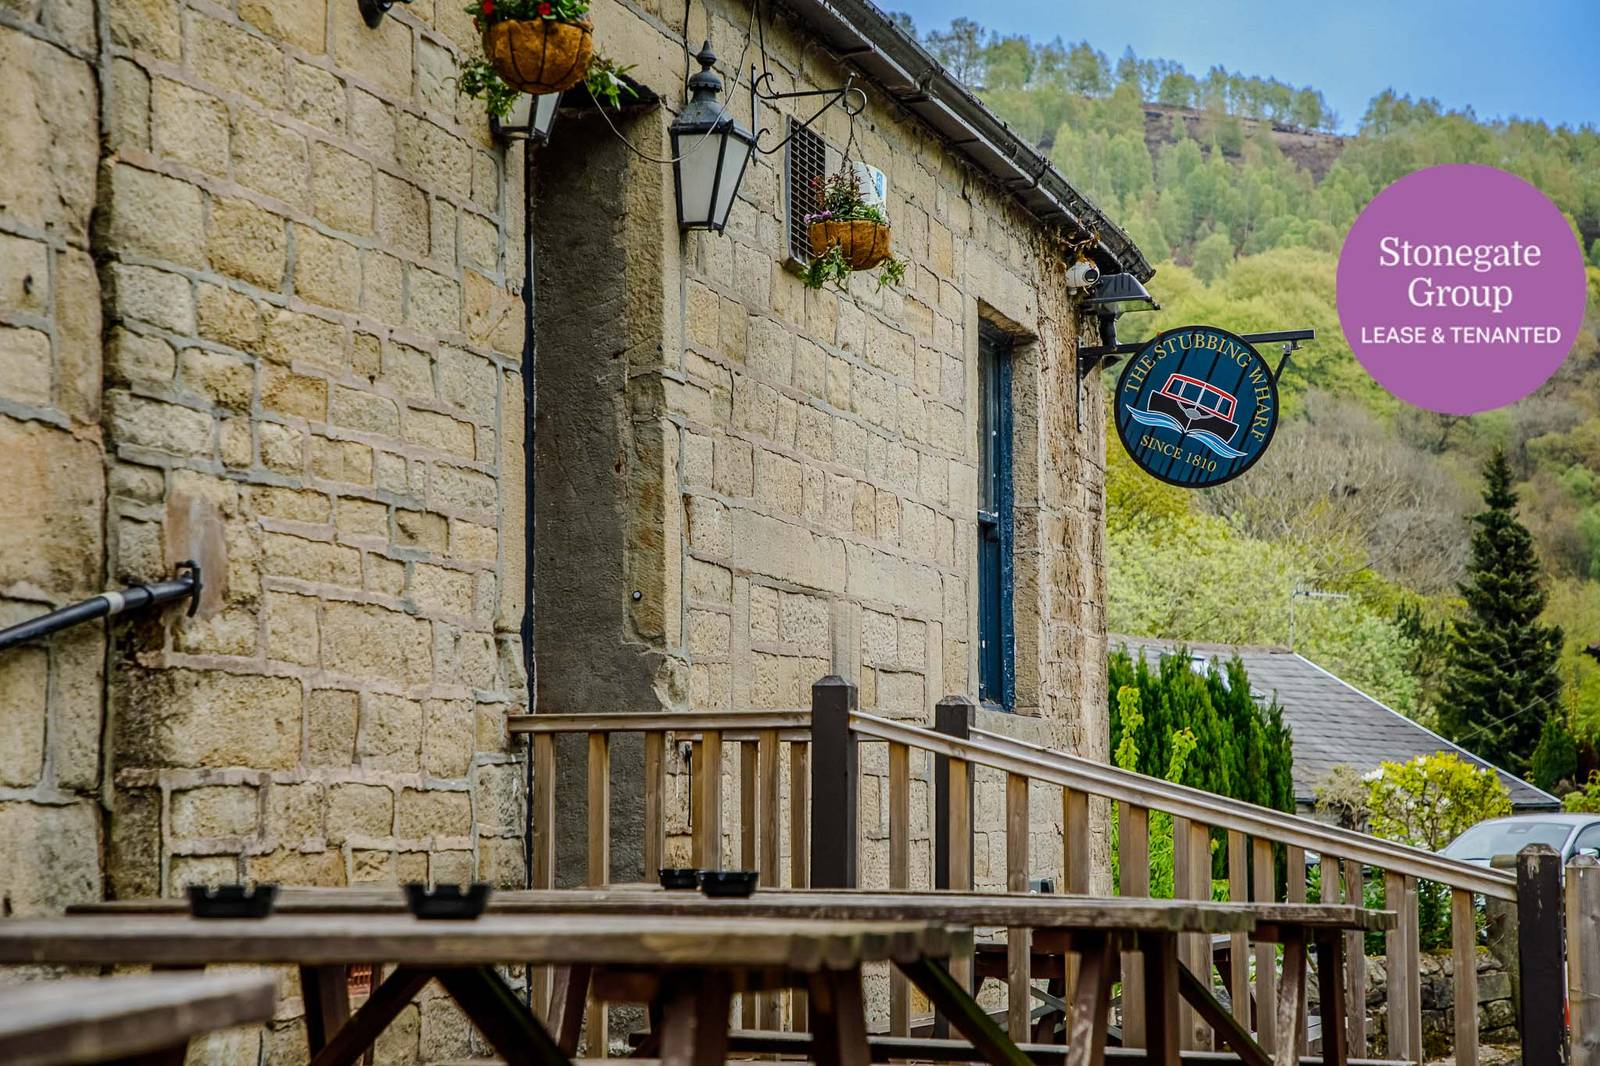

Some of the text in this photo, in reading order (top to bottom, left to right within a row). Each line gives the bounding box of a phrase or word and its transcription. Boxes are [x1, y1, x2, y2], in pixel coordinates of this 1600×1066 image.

[1125, 333, 1271, 443] THE STUBBING WHARF
[1140, 434, 1217, 473] SINCE 1810
